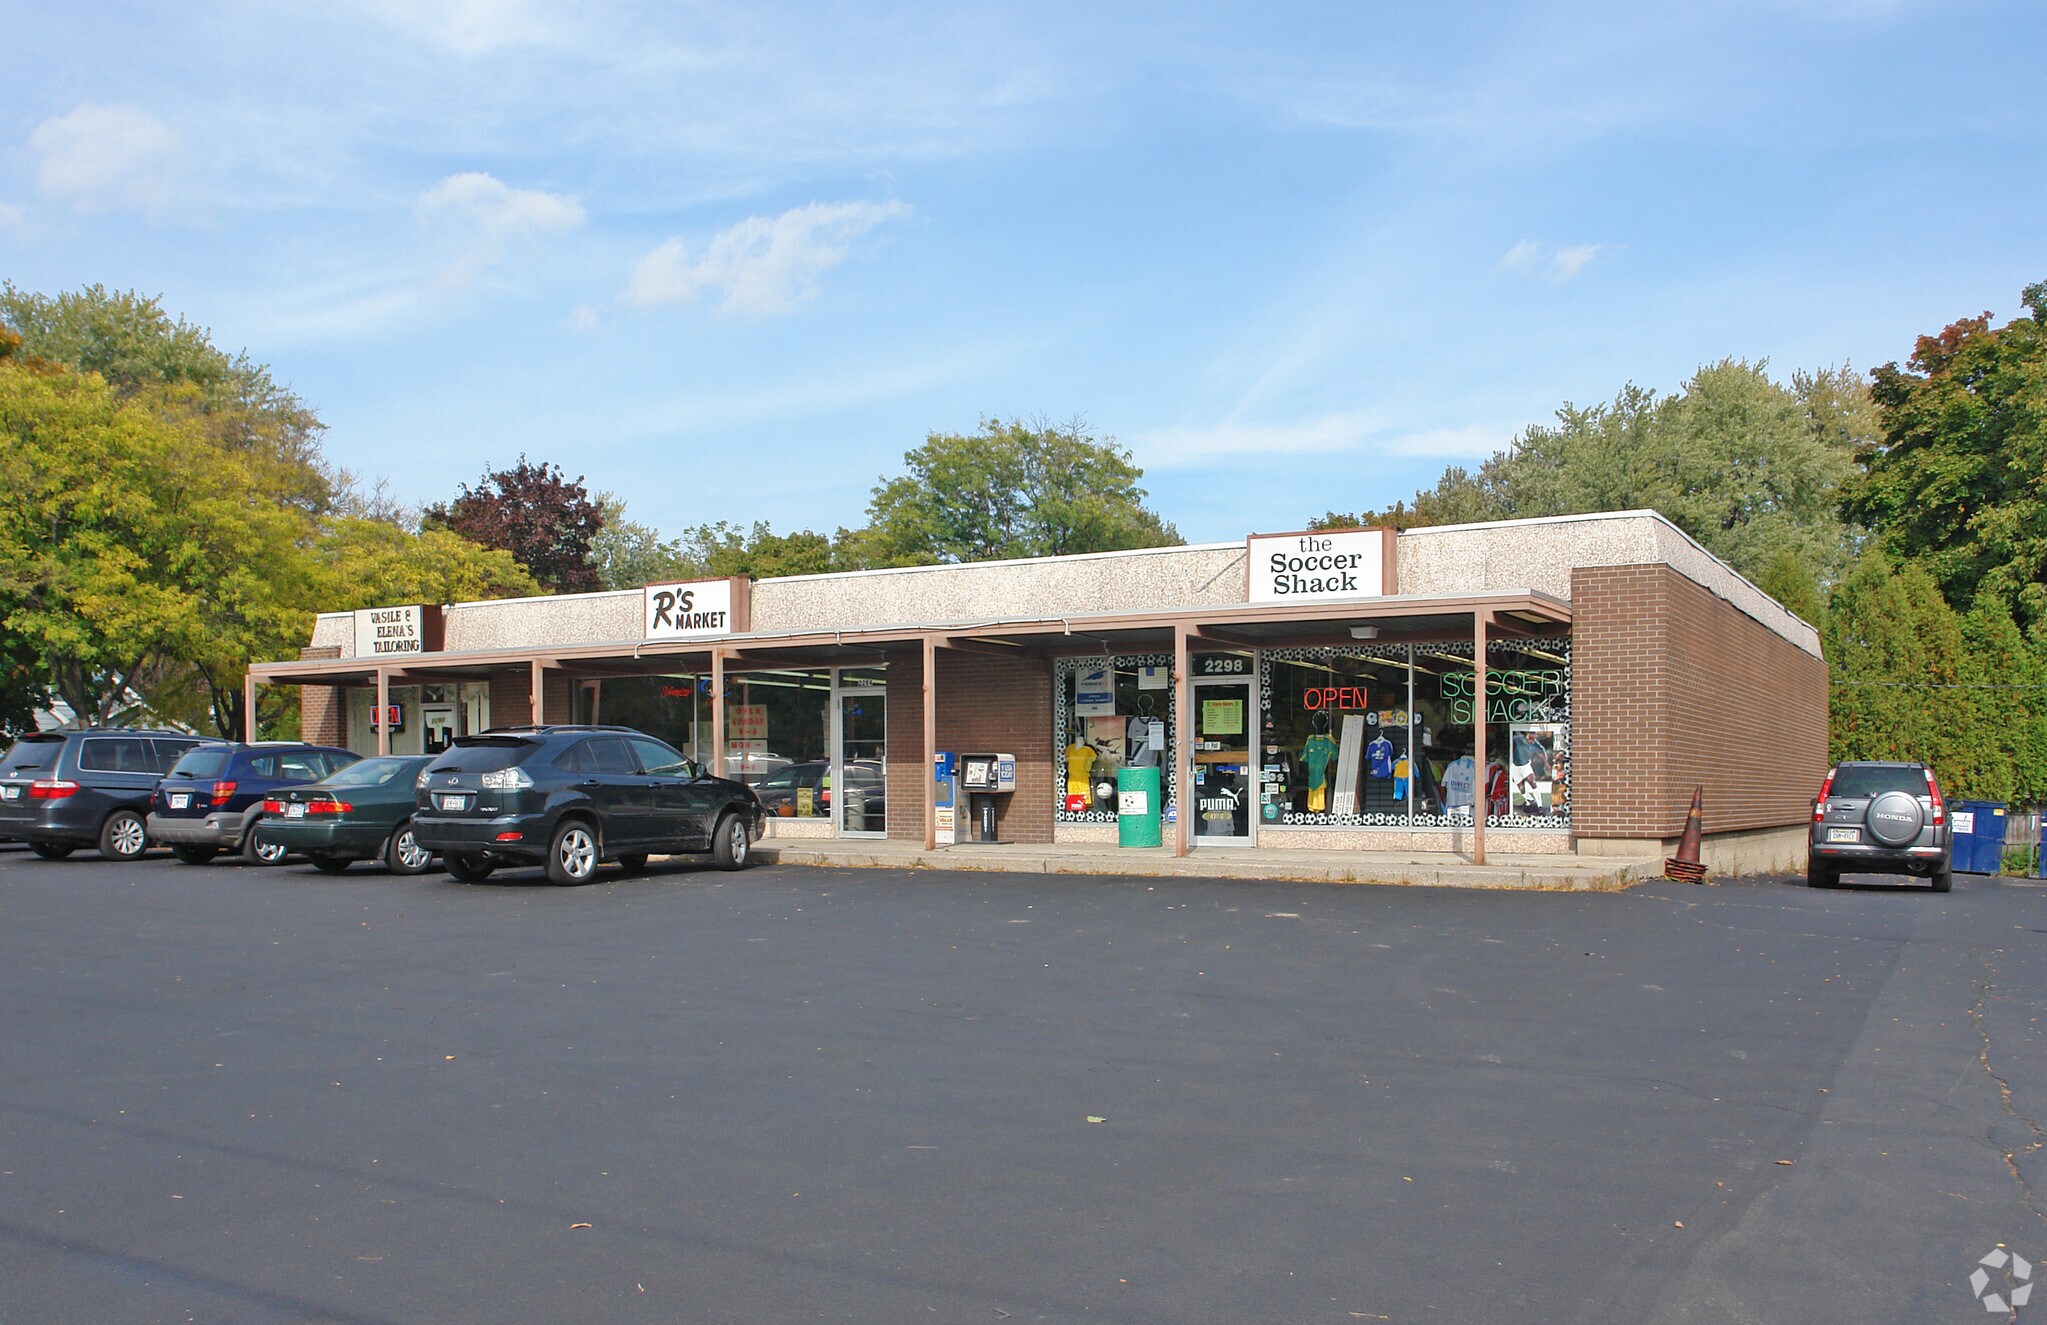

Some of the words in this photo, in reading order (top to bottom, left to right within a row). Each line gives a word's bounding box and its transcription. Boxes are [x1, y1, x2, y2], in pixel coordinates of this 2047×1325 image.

[1299, 536, 1332, 553] the
[1270, 553, 1362, 573] Soccer
[1273, 571, 1358, 595] Shack
[370, 610, 402, 624] VASILE
[675, 611, 726, 630] MARKET
[376, 624, 414, 638] ELENA'S
[373, 639, 420, 653] TAILORING
[1204, 659, 1243, 673] 2298
[1443, 670, 1560, 697] SOCCER
[1304, 687, 1367, 710] OPEN
[735, 707, 761, 715] OPEN
[1453, 698, 1549, 724] SHACK
[732, 718, 764, 726] SUNDAY
[730, 741, 751, 749] MON
[1200, 798, 1234, 811] PUMA
[1876, 813, 1914, 823] HONDA
